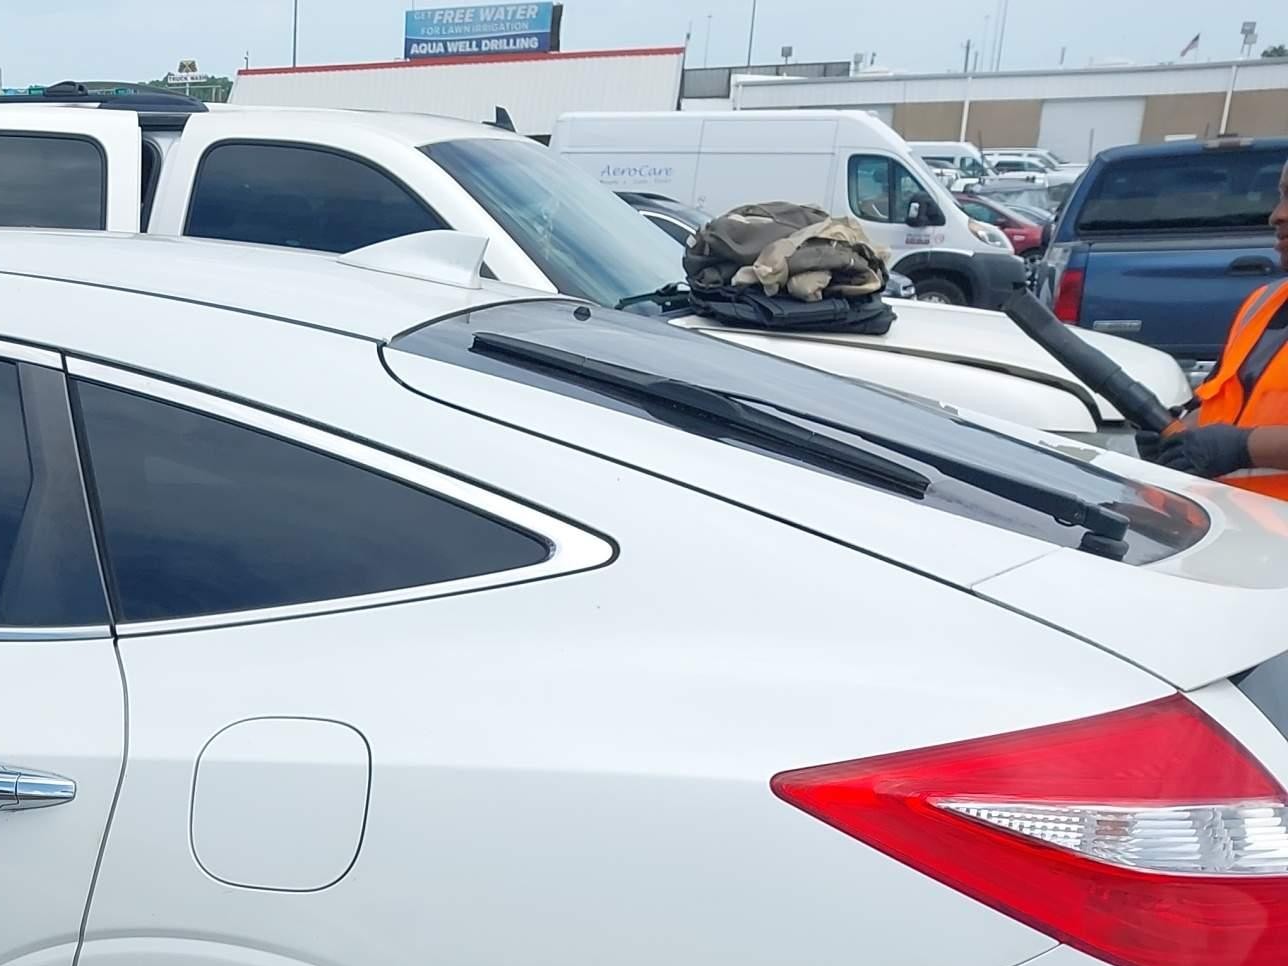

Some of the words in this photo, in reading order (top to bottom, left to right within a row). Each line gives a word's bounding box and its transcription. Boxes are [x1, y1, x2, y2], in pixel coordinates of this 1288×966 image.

[414, 11, 432, 20] GET
[433, 10, 475, 24] FREE
[479, 5, 538, 21] WATER
[421, 26, 440, 35] FOR
[442, 24, 471, 34] LAWN
[472, 21, 529, 33] IRRIGATION
[410, 42, 445, 54] AQUA
[446, 39, 479, 52] WELL
[481, 37, 538, 51] DRILLING
[600, 165, 672, 176] AeroCare
